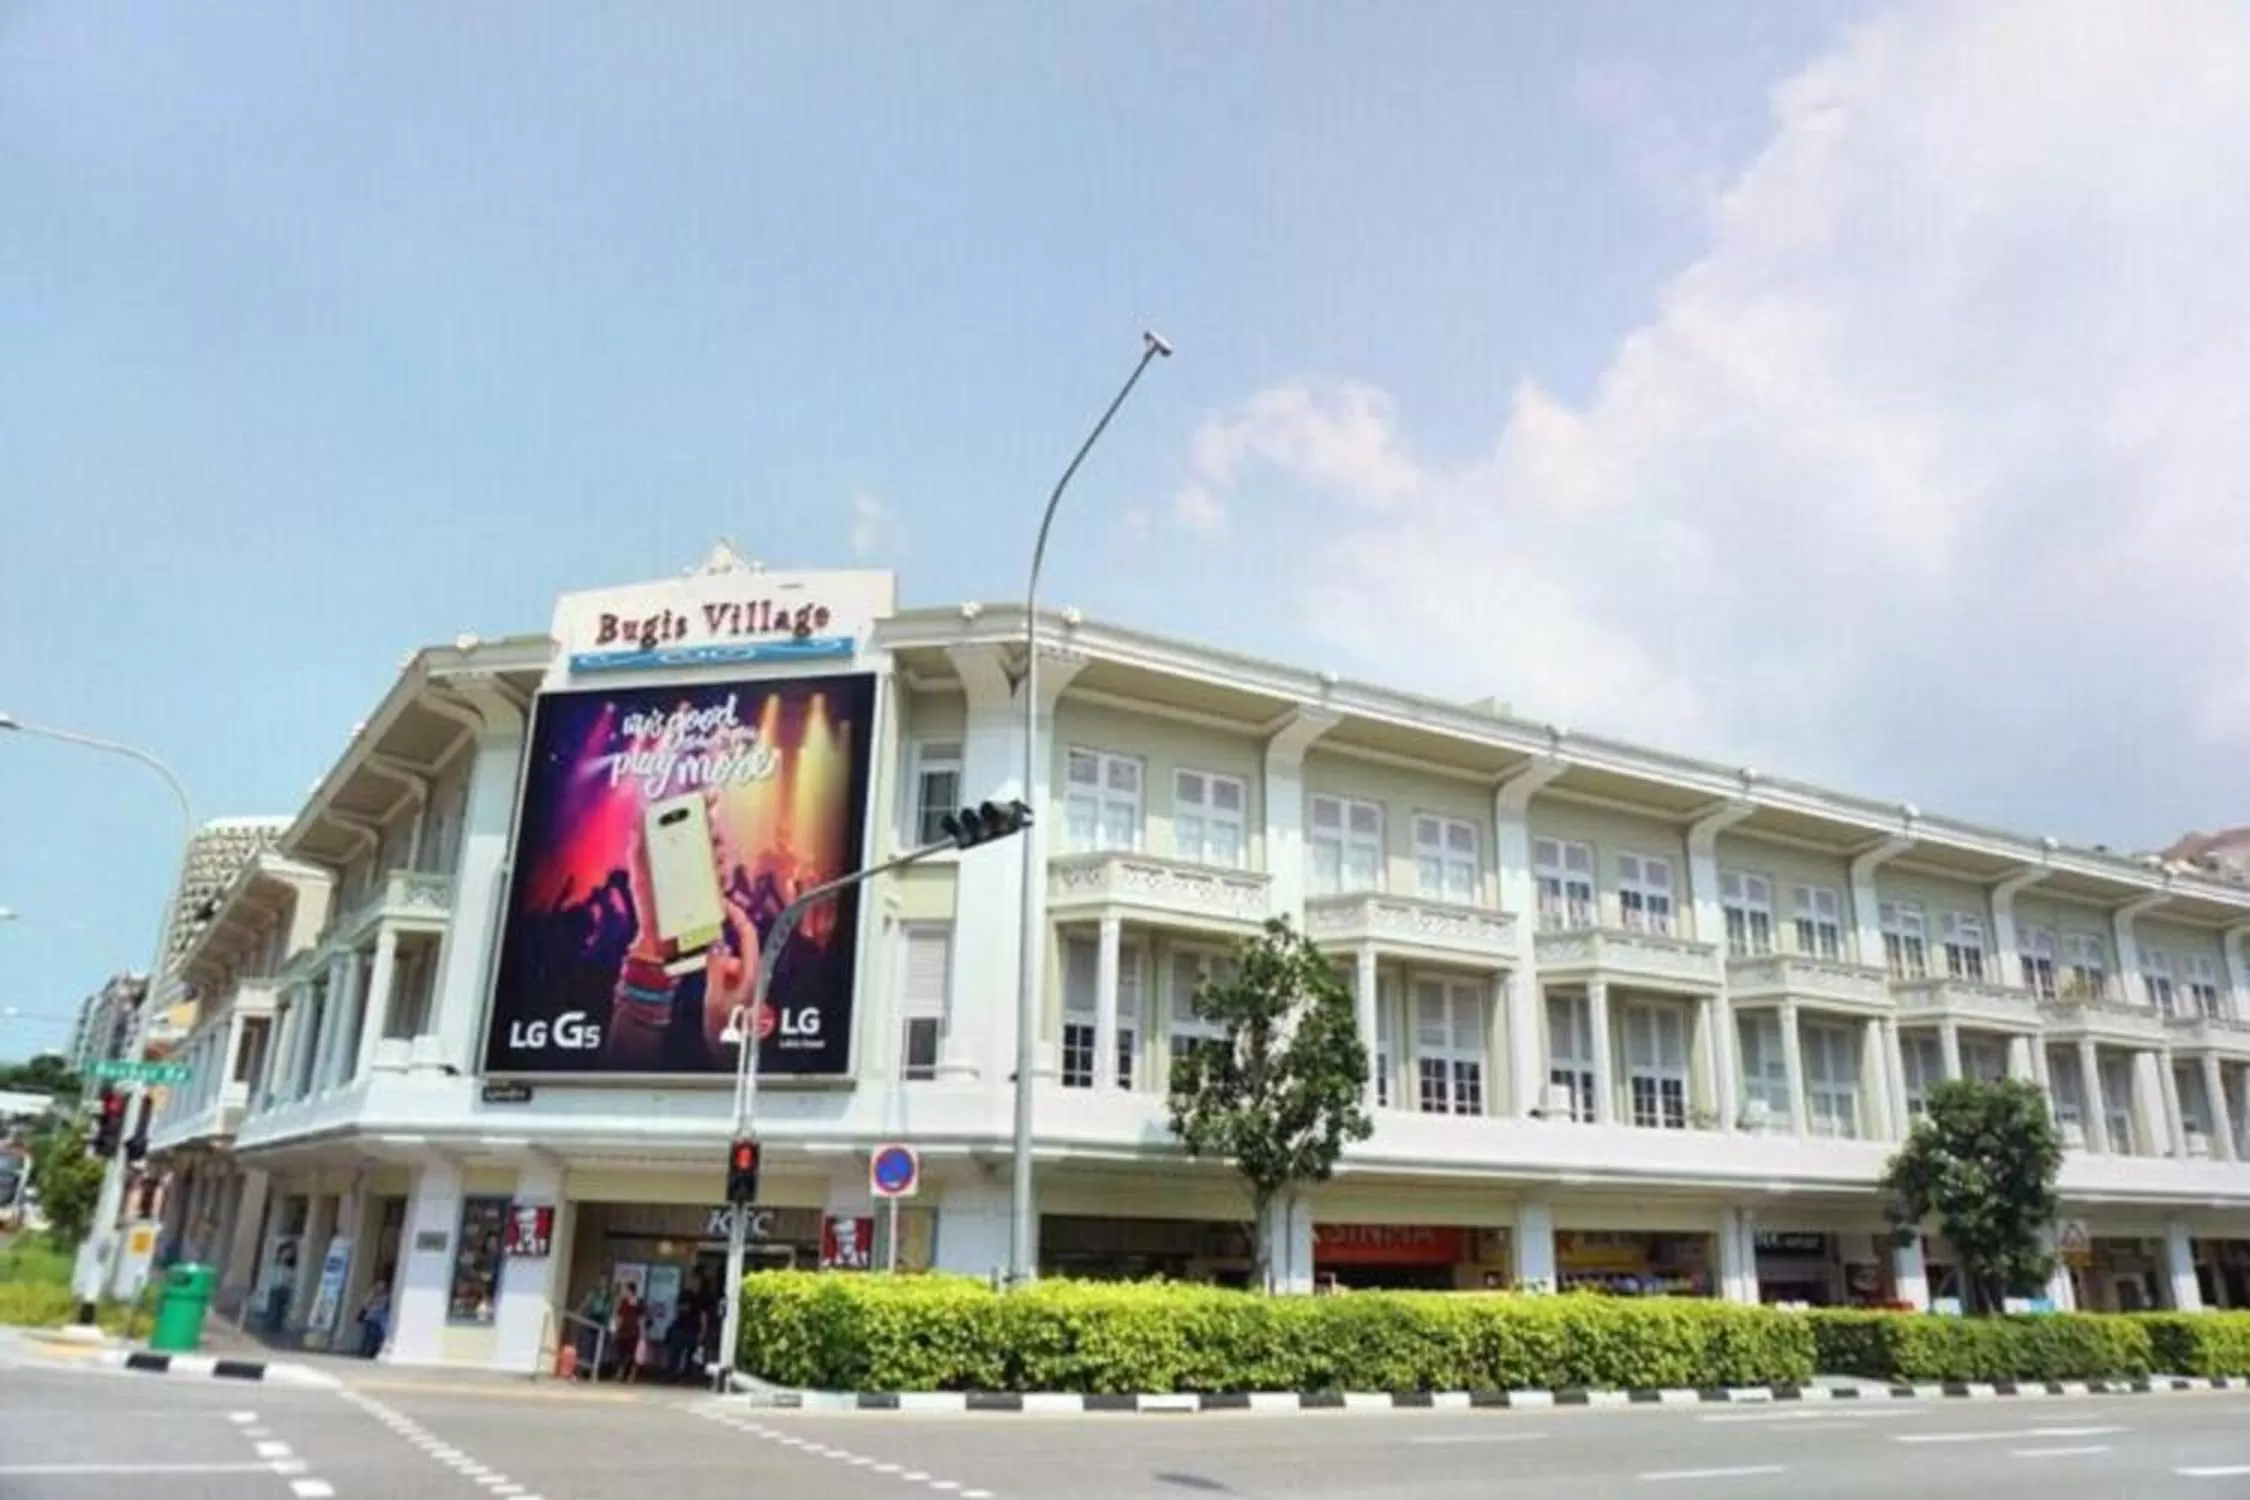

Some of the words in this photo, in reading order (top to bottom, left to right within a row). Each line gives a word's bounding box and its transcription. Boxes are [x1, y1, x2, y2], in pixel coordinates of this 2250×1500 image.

[596, 609, 688, 650] Bugis
[703, 599, 830, 639] Village
[509, 1019, 548, 1049] LG
[552, 1010, 601, 1049] G5
[780, 1006, 820, 1035] LG
